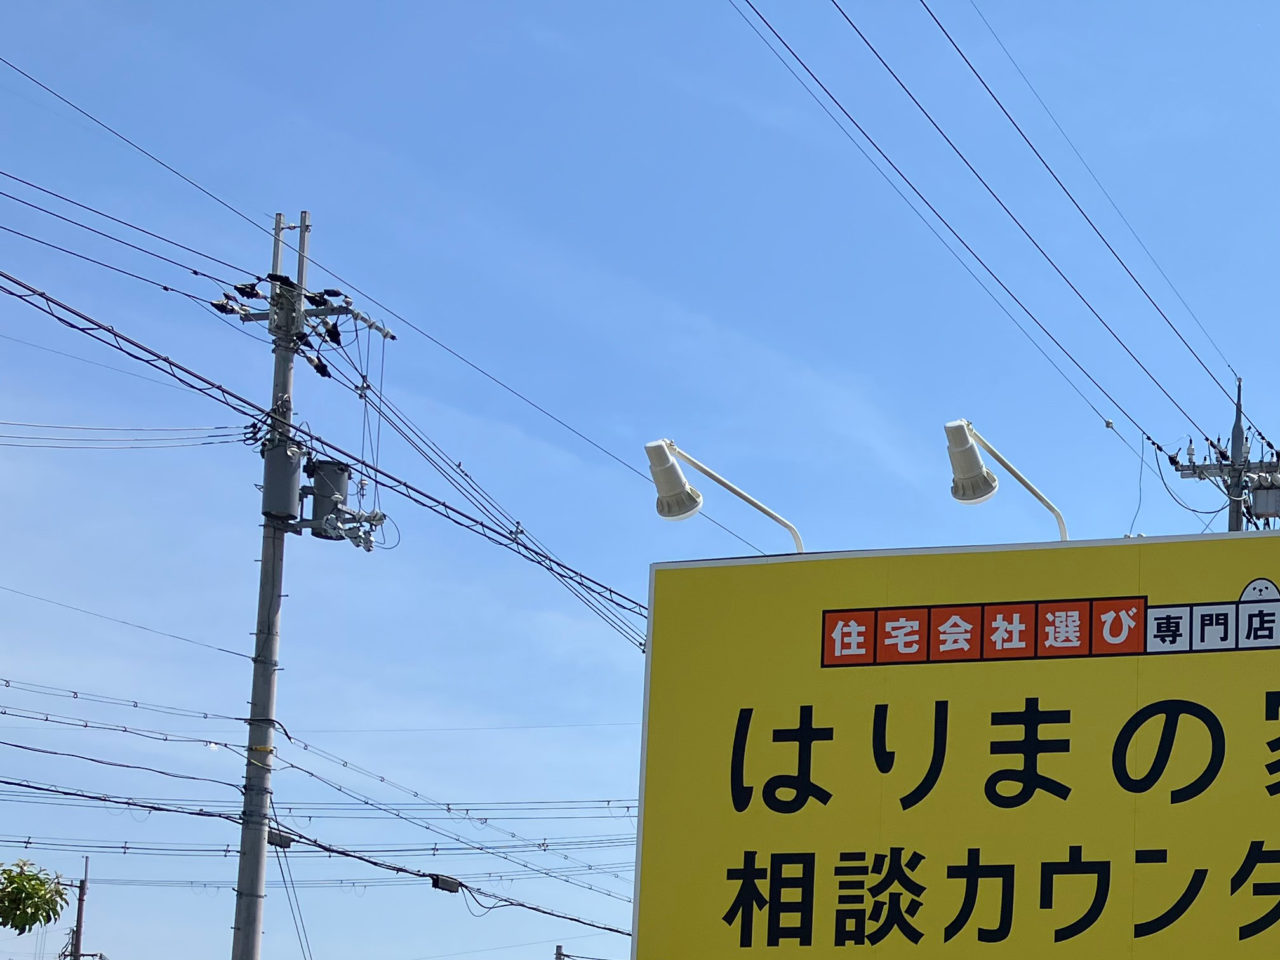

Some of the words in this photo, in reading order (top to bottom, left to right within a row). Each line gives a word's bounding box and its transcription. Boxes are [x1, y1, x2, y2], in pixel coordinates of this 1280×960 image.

[831, 606, 1138, 658] 住宅会社選び
[1153, 610, 1277, 645] 専門店
